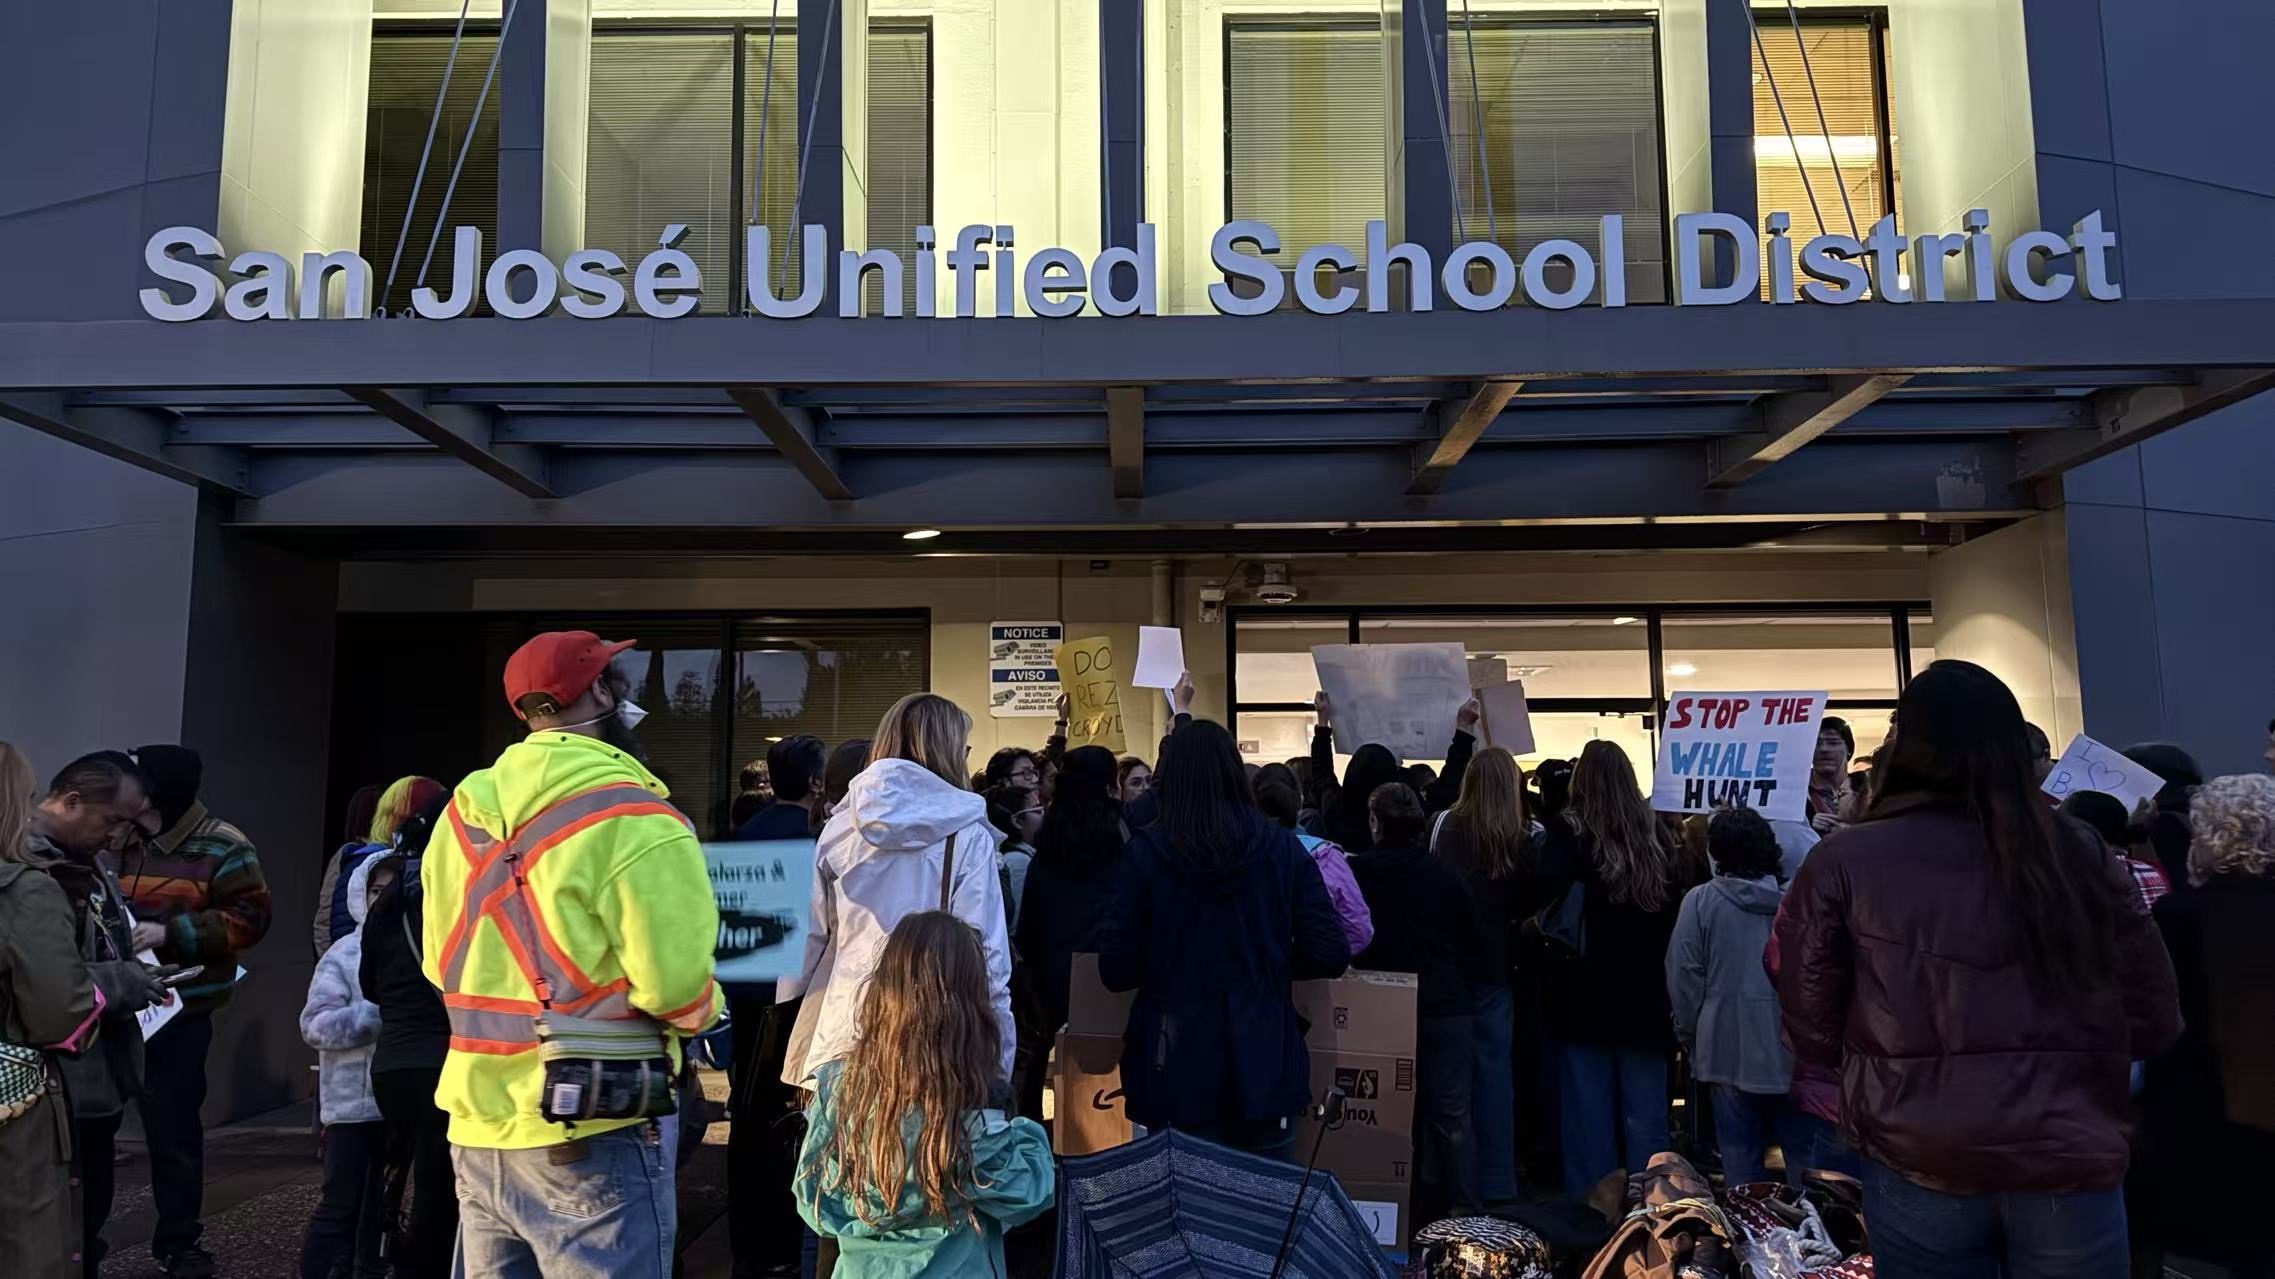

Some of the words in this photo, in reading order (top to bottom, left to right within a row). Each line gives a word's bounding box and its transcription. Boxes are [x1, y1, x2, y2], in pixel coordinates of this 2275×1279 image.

[139, 226, 374, 322] San
[411, 223, 704, 320] José
[747, 222, 1156, 319] Unified
[1208, 213, 1626, 316] School
[1672, 208, 2122, 306] District
[1004, 628, 1049, 638] NOTICE
[1008, 671, 1046, 681] AVISO
[1074, 646, 1112, 676] DO
[1076, 681, 1120, 711] REZ
[1670, 698, 1750, 729] STOP
[1761, 698, 1814, 725] THE
[1671, 741, 1779, 778] WHALE
[1683, 778, 1777, 808] HUNT
[2050, 771, 2073, 795] B
[718, 920, 763, 948] her
[1347, 1109, 1378, 1126] You
